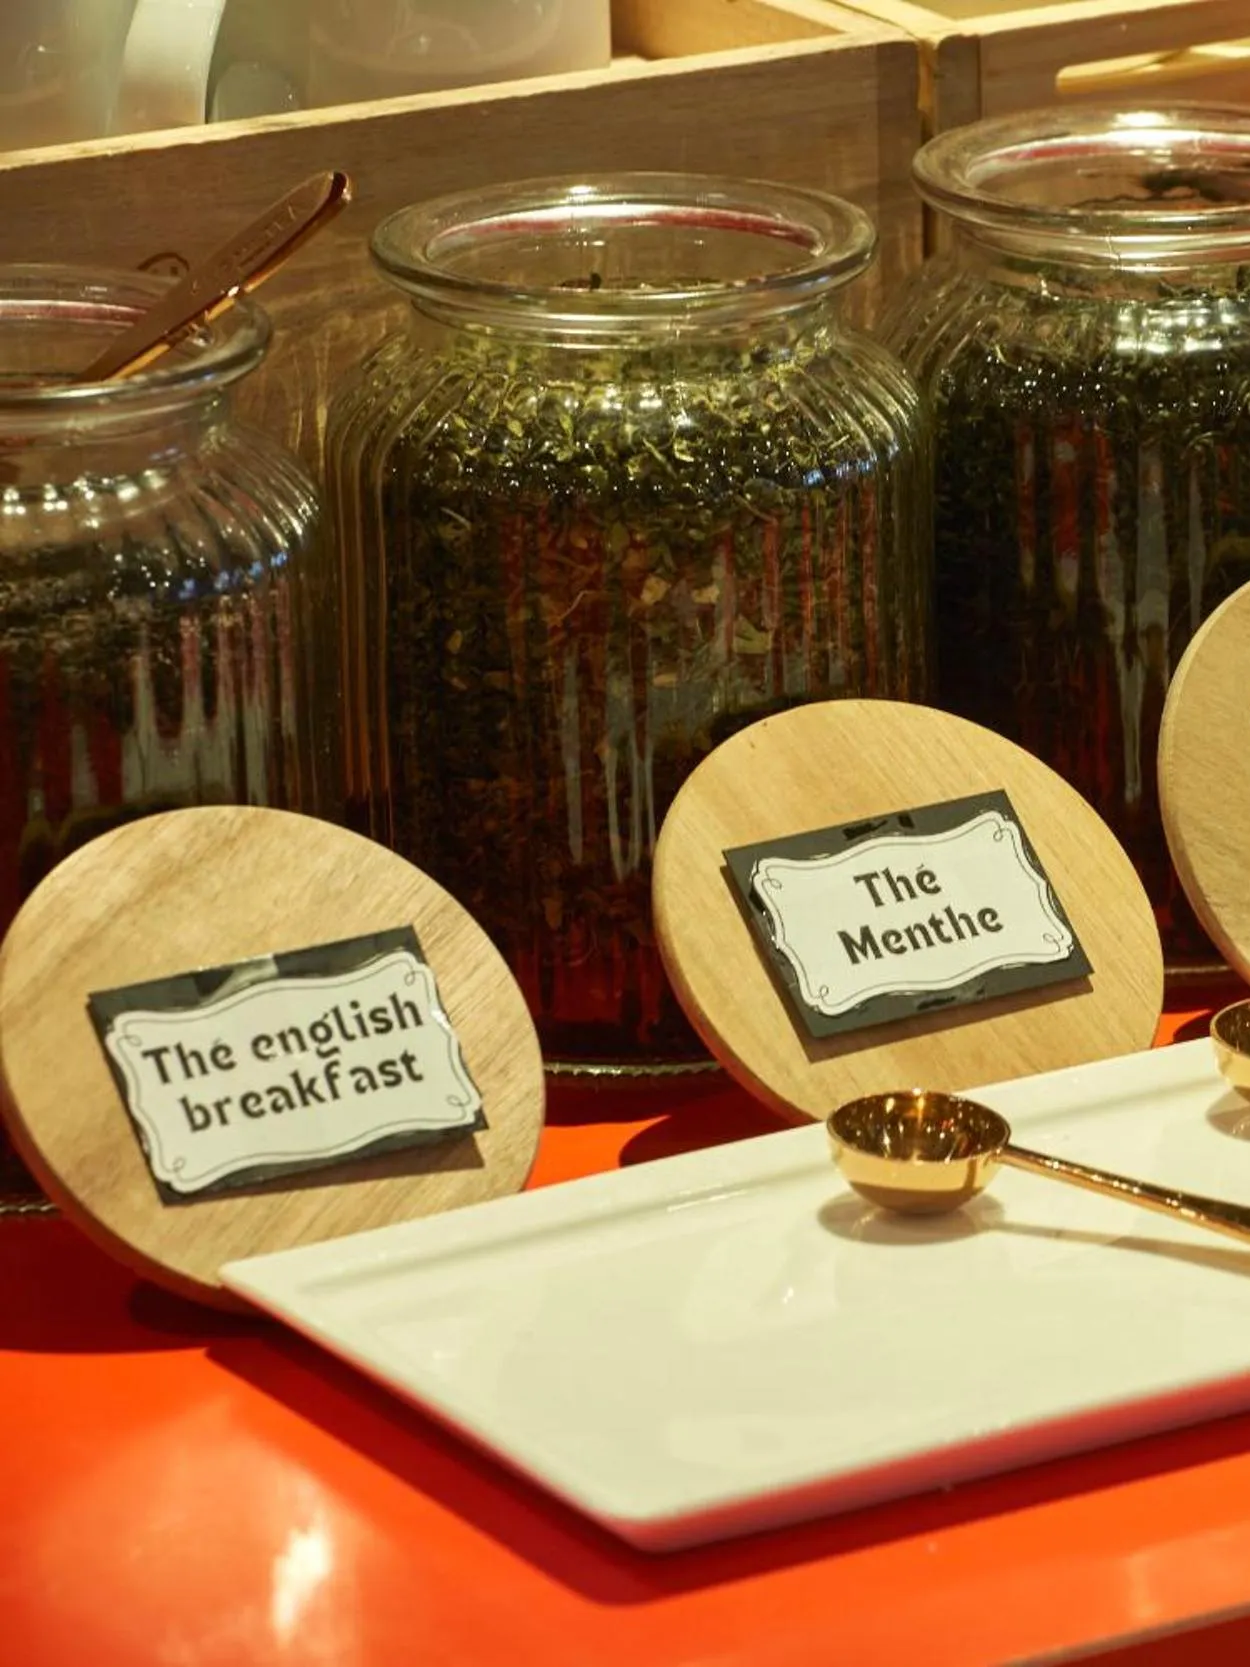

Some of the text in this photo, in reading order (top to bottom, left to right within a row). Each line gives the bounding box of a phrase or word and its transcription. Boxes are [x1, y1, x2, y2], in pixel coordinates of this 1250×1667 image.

[853, 863, 942, 907] Thé
[837, 904, 1004, 965] Menthe
[141, 992, 424, 1085] Thé english
[179, 1049, 424, 1132] breakfast
